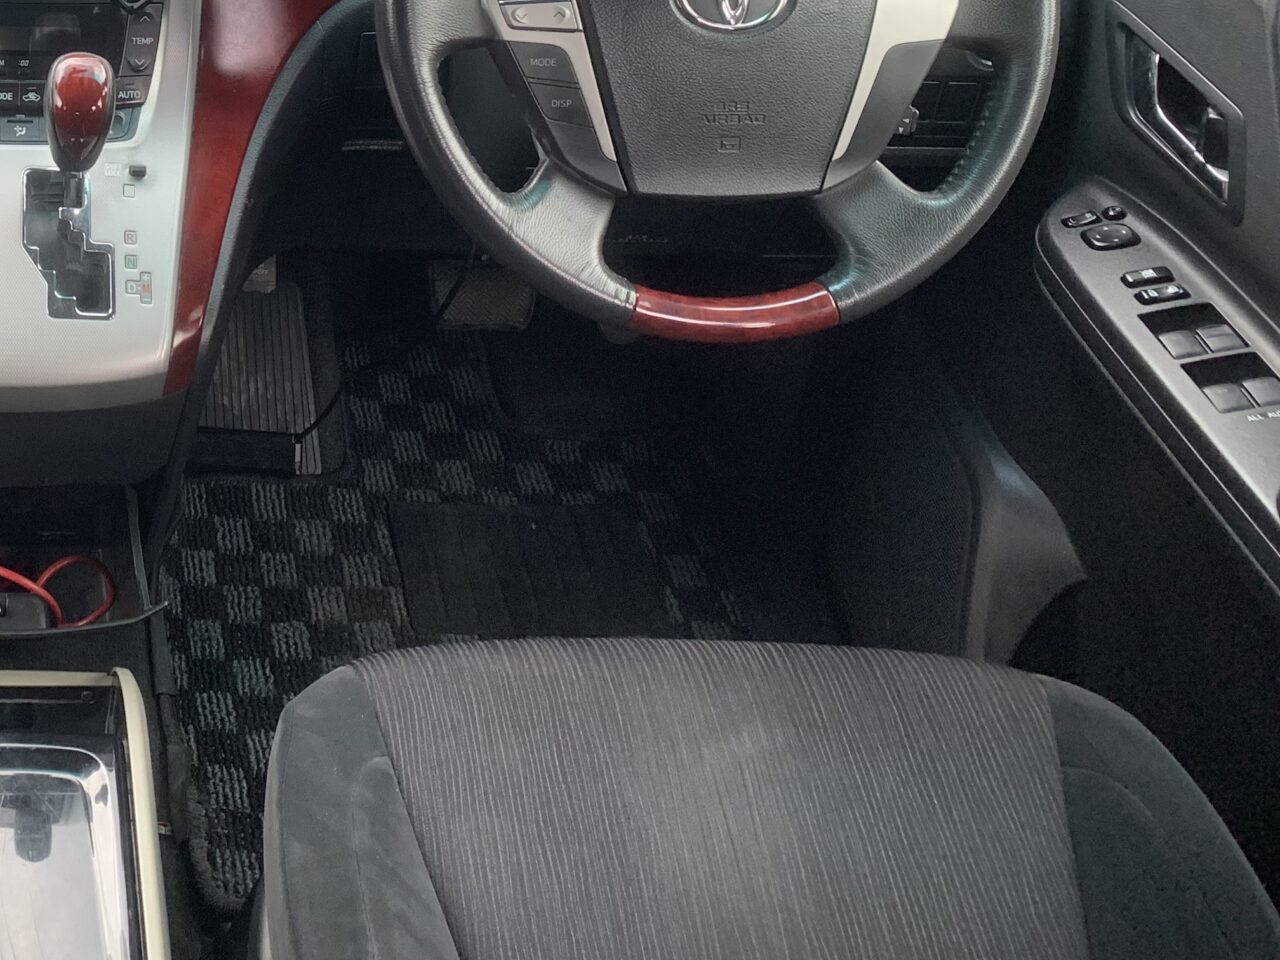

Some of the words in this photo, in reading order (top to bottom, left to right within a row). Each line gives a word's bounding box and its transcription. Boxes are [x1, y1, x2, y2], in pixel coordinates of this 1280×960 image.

[132, 37, 154, 45] TEMP
[529, 58, 557, 67] MODE
[118, 90, 141, 99] AUTO
[551, 99, 572, 108] DISP
[126, 233, 134, 242] R
[127, 257, 136, 266] N
[1246, 414, 1265, 422] ALL
[1267, 410, 1280, 419] AU
